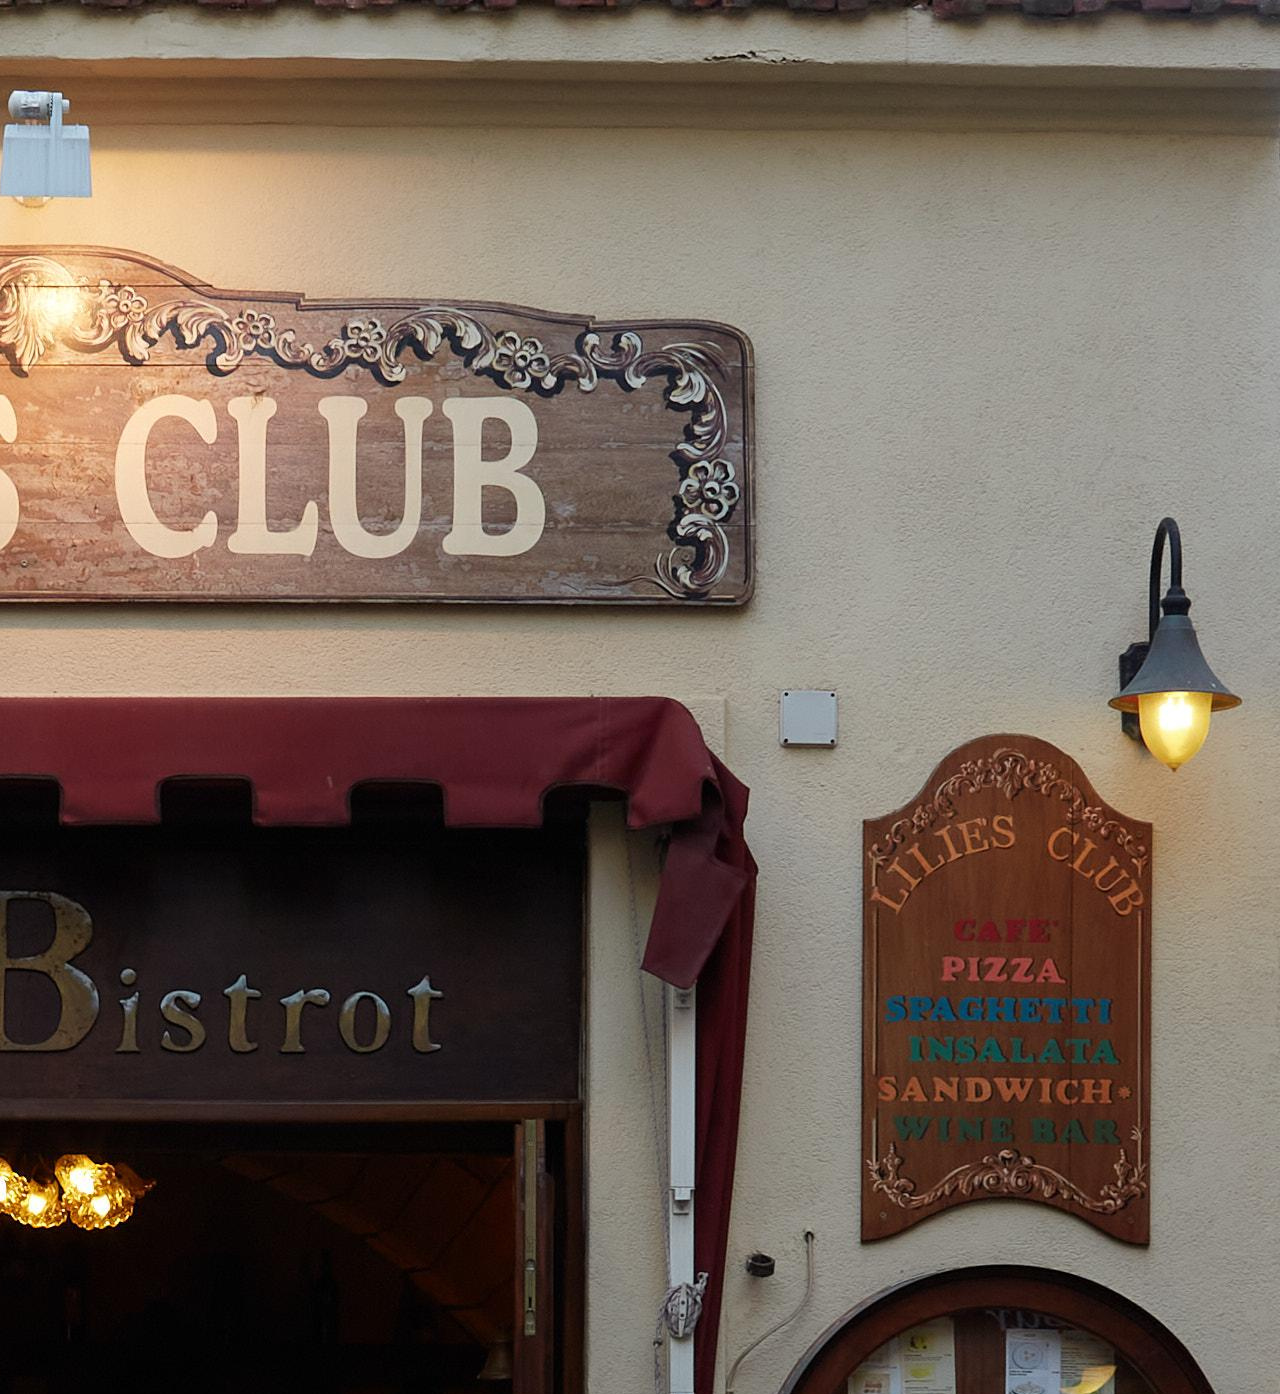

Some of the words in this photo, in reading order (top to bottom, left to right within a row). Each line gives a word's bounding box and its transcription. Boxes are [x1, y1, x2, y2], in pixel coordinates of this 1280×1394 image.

[116, 393, 546, 559] CLUB
[871, 814, 1016, 915] LILIE'S
[1046, 826, 1145, 918] CLUB
[940, 956, 1067, 984] PIZZA
[884, 995, 1113, 1025] SPAGHETTI
[907, 1036, 1120, 1065] INSALATA
[894, 1116, 1016, 1144] WINE
[1032, 1116, 1121, 1145] BAR
